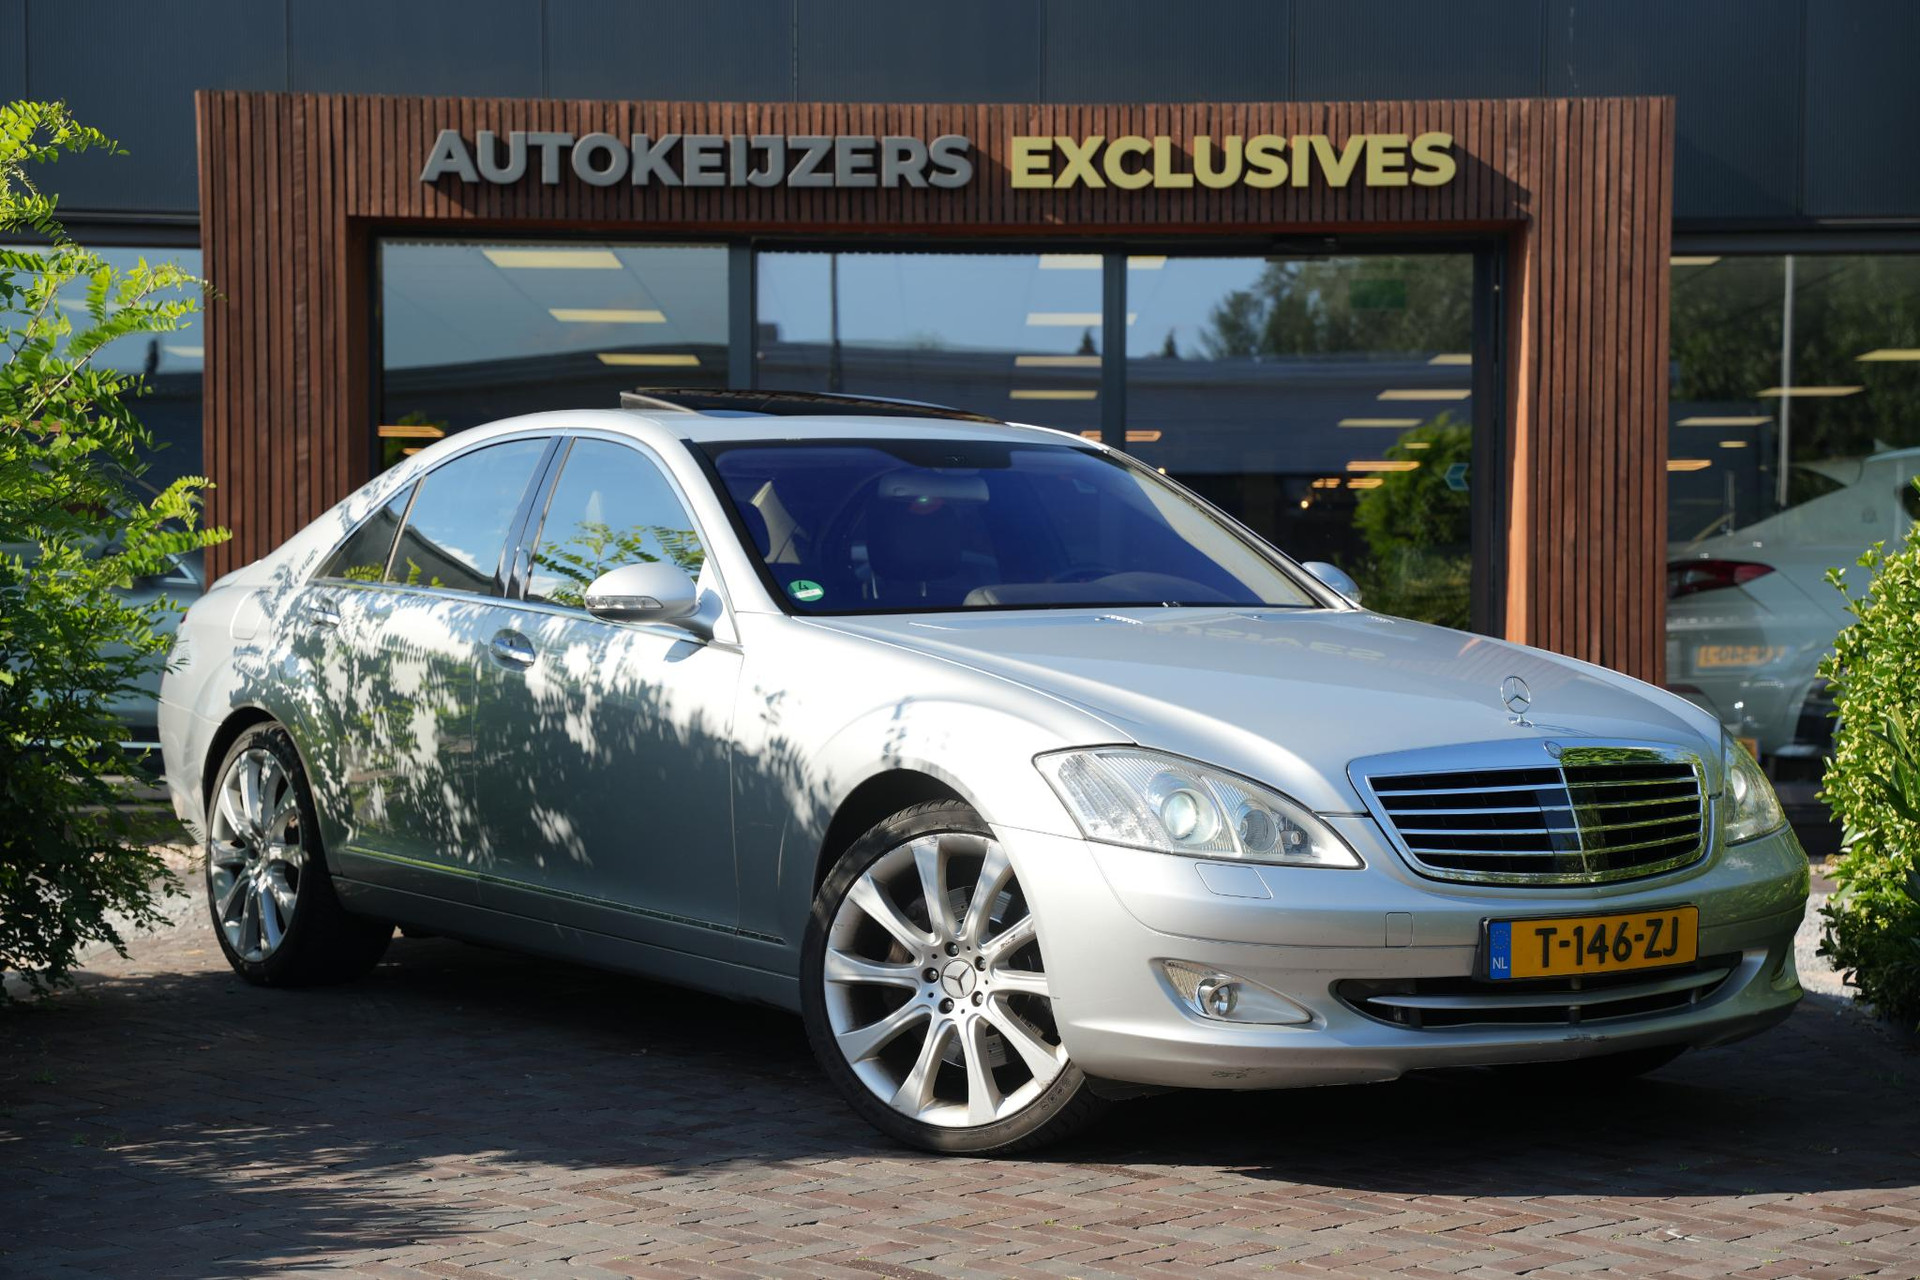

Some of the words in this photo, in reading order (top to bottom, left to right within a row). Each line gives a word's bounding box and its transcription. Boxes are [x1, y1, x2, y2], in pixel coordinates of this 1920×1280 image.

[420, 129, 973, 189] AUTOKEIJZERS
[1011, 131, 1457, 189] EXCLUSIVES
[1492, 956, 1508, 969] NL
[1535, 916, 1679, 968] T-146-ZJ
